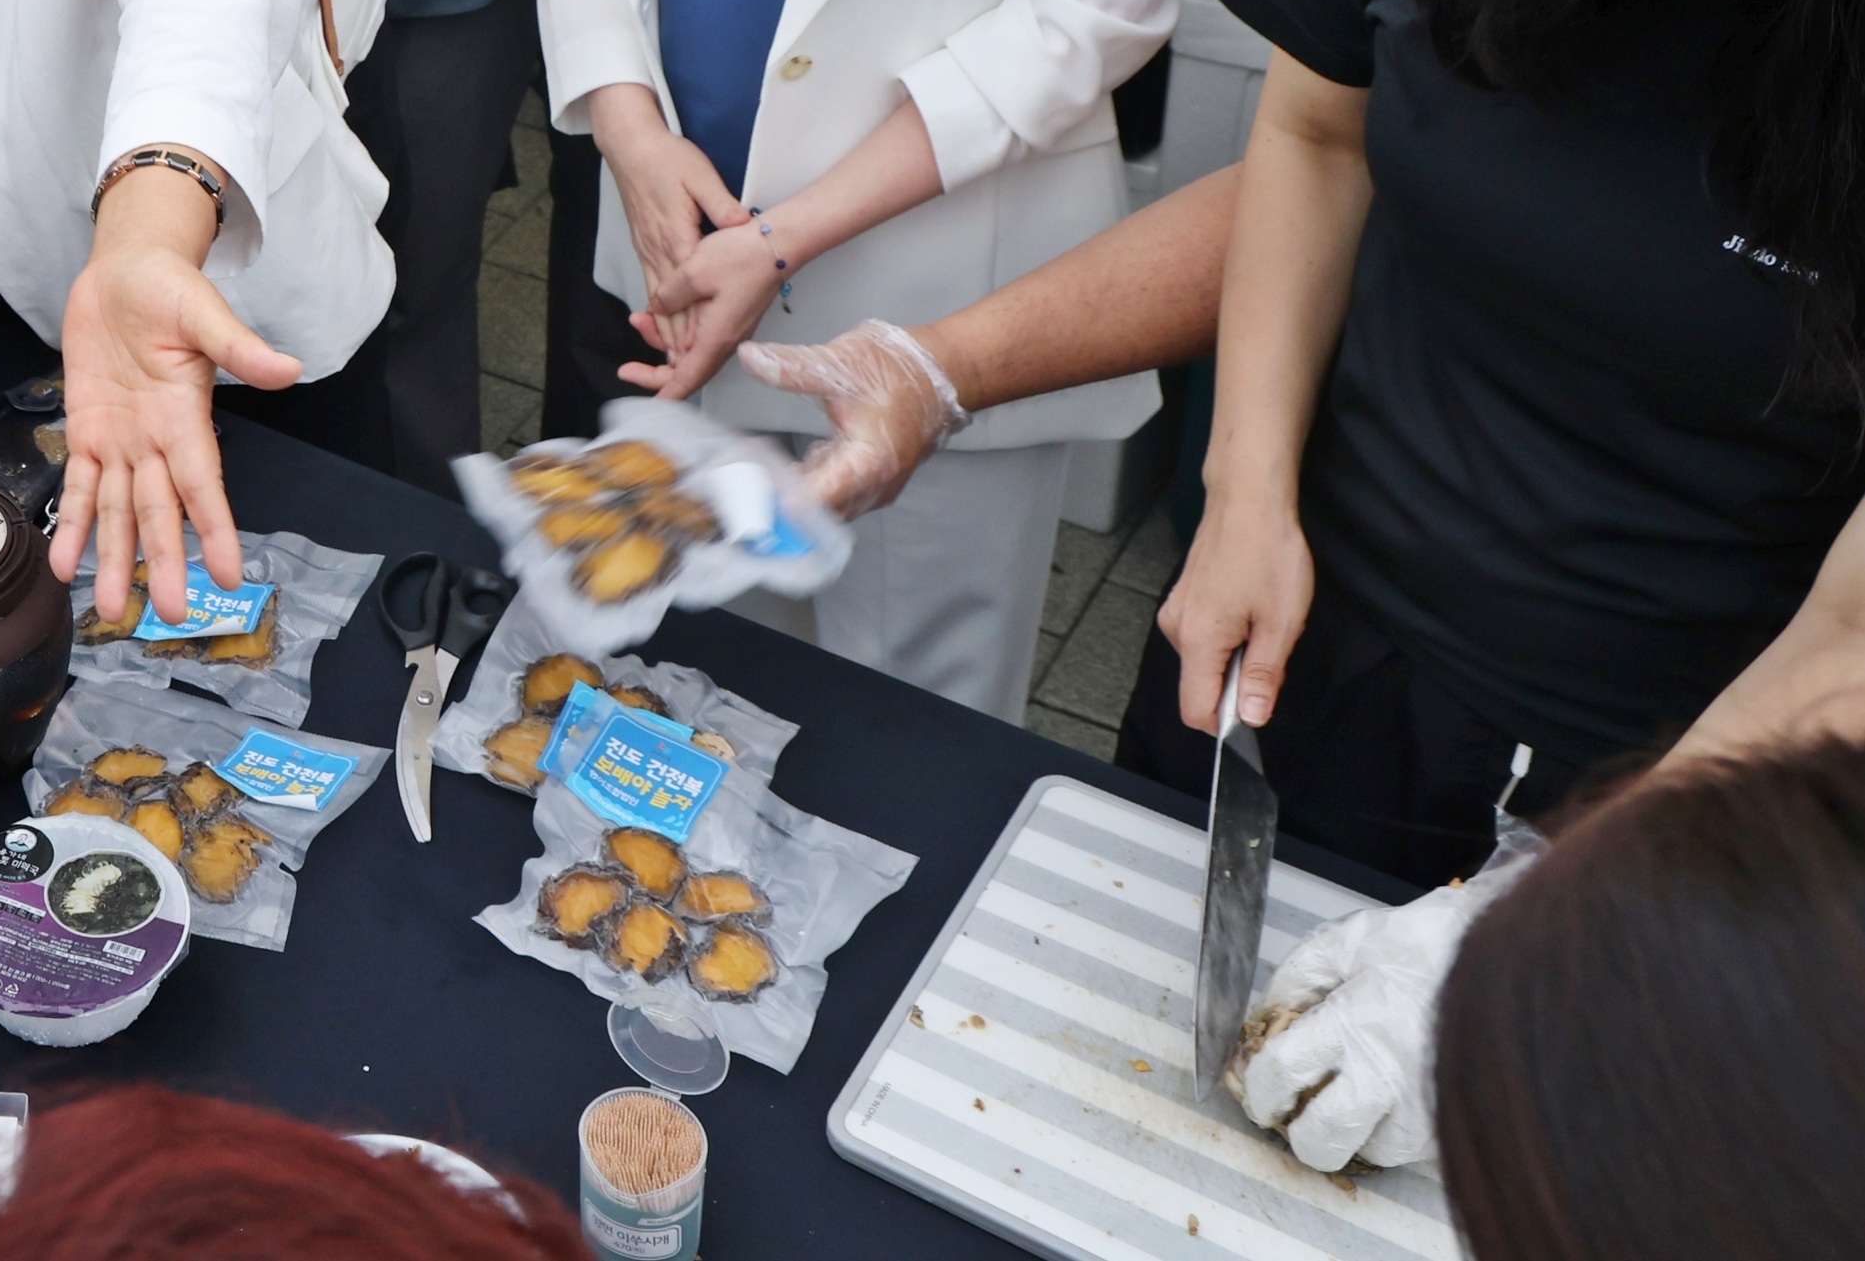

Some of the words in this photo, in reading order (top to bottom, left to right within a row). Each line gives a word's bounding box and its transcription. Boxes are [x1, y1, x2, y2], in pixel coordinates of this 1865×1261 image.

[203, 592, 254, 613] 건전복
[234, 763, 287, 786] 보배야
[243, 749, 280, 767] 진도
[282, 761, 336, 786] 건전복
[606, 736, 645, 767] 진도
[646, 757, 705, 799] 건전복
[589, 769, 641, 809] 영어조합법인
[592, 755, 653, 796] 보배야
[649, 786, 694, 811] 놀자
[8, 857, 41, 876] 미역국
[616, 1230, 670, 1248] 이쑤시개
